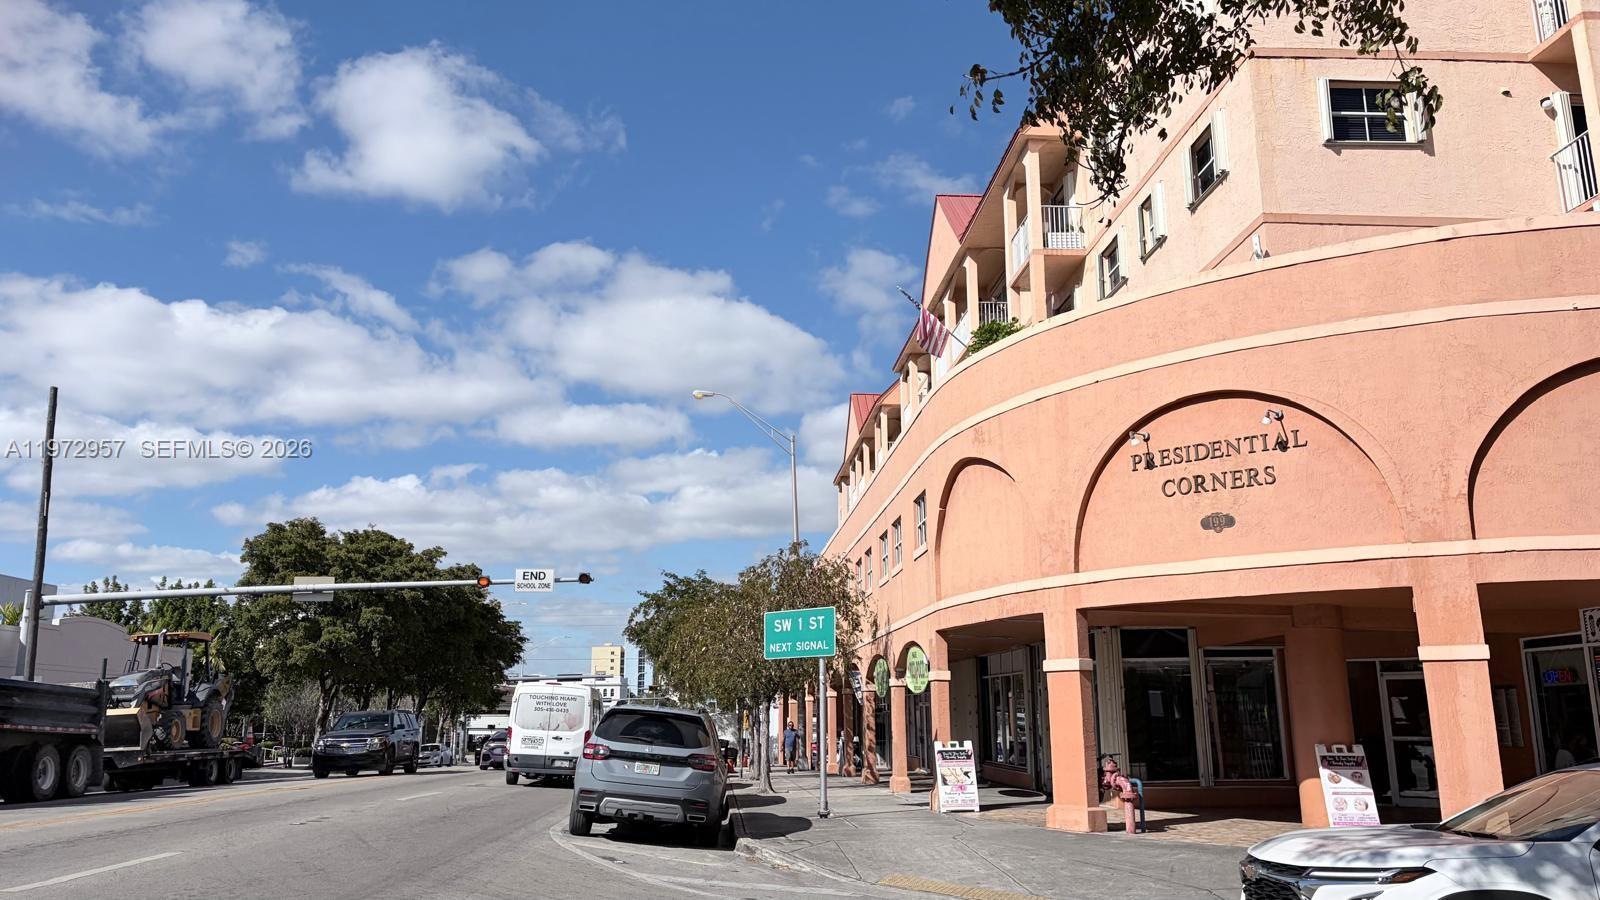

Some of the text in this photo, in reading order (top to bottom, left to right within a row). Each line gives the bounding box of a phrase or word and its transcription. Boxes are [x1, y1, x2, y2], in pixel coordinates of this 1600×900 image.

[1130, 429, 1308, 472] PRESIDENTIAL
[1161, 465, 1277, 498] CORNERS
[1209, 516, 1226, 528] 199
[522, 571, 546, 581] END
[774, 615, 825, 632] SW 1 ST
[769, 640, 829, 653] NEXT SIGNAL
[1544, 670, 1573, 683] OPEN
